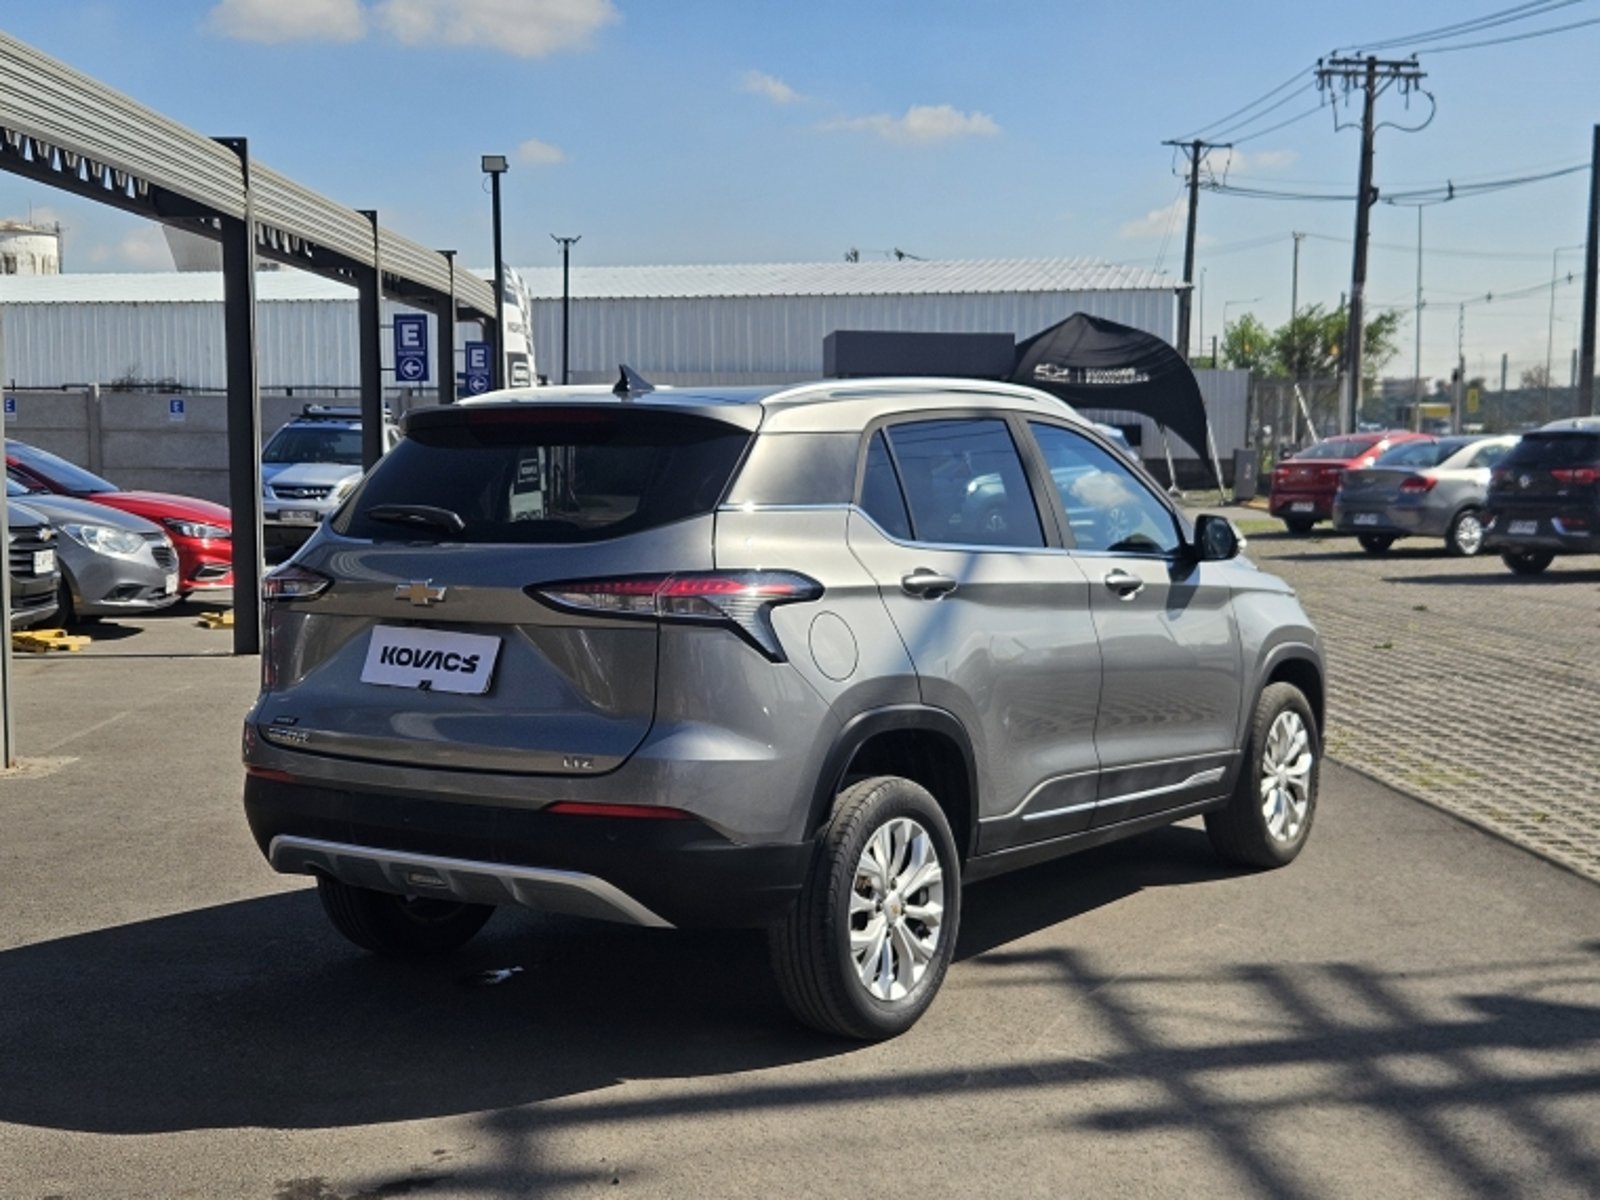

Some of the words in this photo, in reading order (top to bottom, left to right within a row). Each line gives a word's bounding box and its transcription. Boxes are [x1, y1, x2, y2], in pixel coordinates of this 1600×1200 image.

[402, 324, 419, 346] E
[471, 349, 485, 367] E
[380, 646, 480, 674] KOVACS
